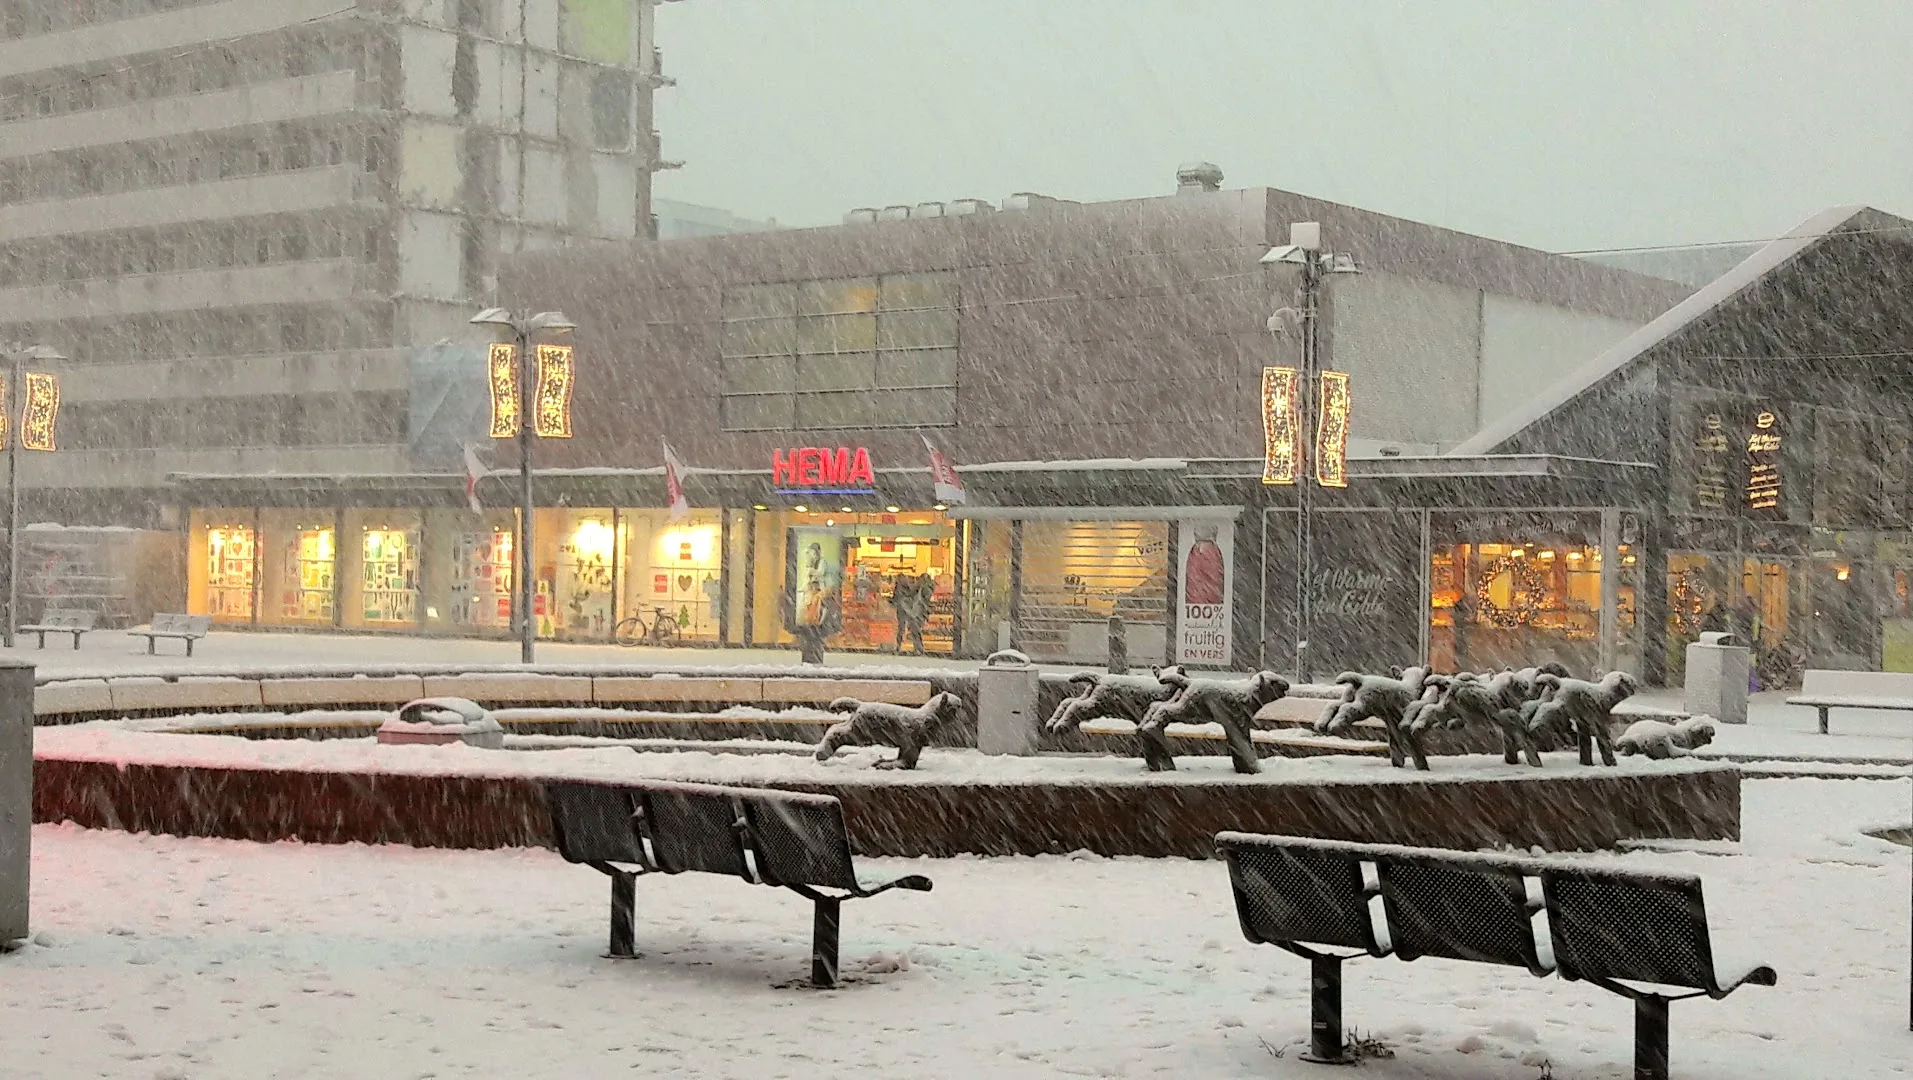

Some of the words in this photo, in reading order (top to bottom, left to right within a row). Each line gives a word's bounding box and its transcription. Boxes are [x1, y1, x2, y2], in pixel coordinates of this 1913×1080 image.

[773, 447, 875, 485] HEMA
[1185, 605, 1224, 619] 100%
[1185, 630, 1225, 649] fruitig
[1184, 649, 1197, 658] EN
[1200, 649, 1225, 660] VERS
